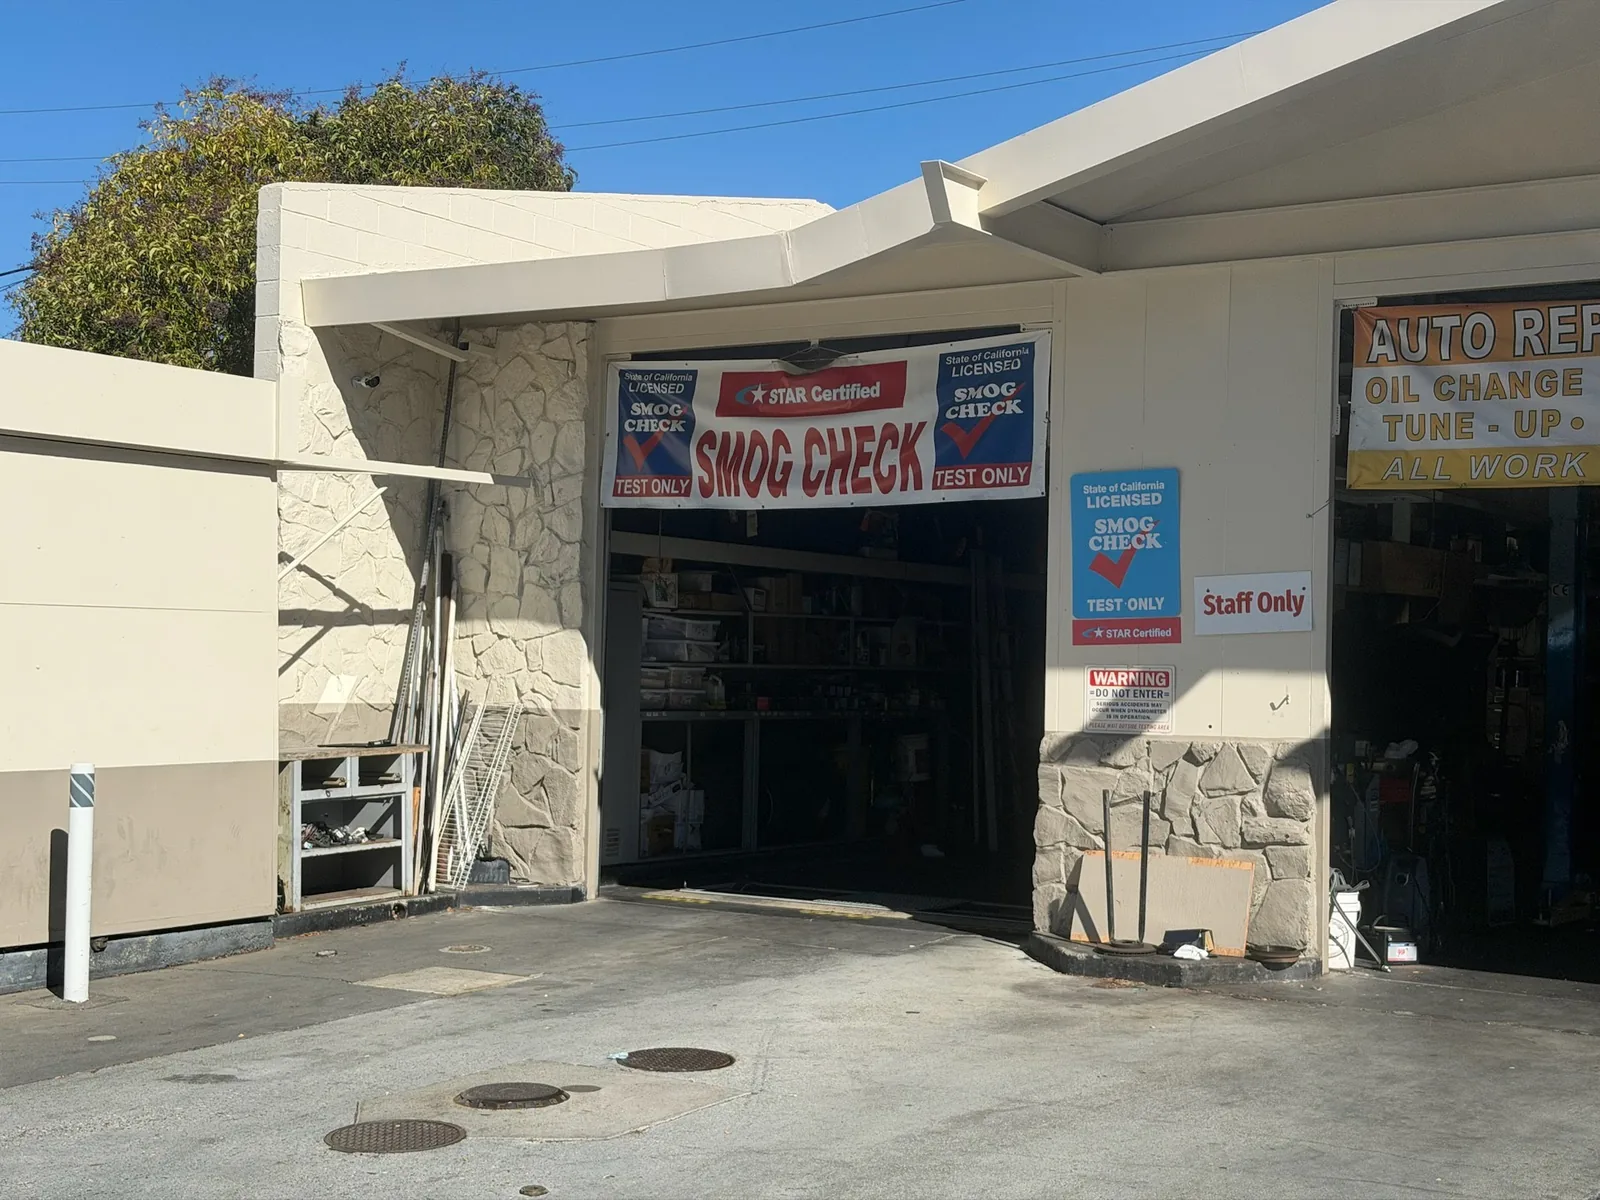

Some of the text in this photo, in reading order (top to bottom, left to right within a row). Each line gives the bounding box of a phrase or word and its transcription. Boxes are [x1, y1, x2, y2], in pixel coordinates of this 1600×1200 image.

[1366, 311, 1496, 363] AUTO
[945, 346, 1029, 365] State of California
[644, 372, 653, 381] of
[654, 372, 693, 381] California
[951, 358, 1021, 378] LICENSED
[628, 382, 685, 394] LICENSED
[768, 381, 881, 405] STAR Certified
[954, 381, 1017, 403] SMOG
[1365, 368, 1583, 404] OIL CHANGE
[630, 402, 683, 416] SMOG
[945, 399, 1024, 420] CHECK
[624, 419, 686, 432] CHECK
[1382, 412, 1475, 442] TUNE
[1514, 409, 1561, 439] UP
[696, 421, 928, 499] SMOG CHECK
[1381, 452, 1590, 481] ALL WORK
[935, 466, 1029, 487] TEST ONLY
[616, 478, 690, 495] TEST ONLY
[1083, 480, 1165, 495] State of California
[1086, 492, 1163, 509] LICENSED
[1094, 516, 1155, 534] SMOG
[1088, 533, 1162, 551] CHECK
[1087, 597, 1165, 612] TEST ONLY
[1203, 589, 1305, 617] Staff Only
[1106, 627, 1172, 638] STAR Certified
[1093, 671, 1166, 687] WARNING
[1095, 688, 1163, 699] DO NOT ENTER
